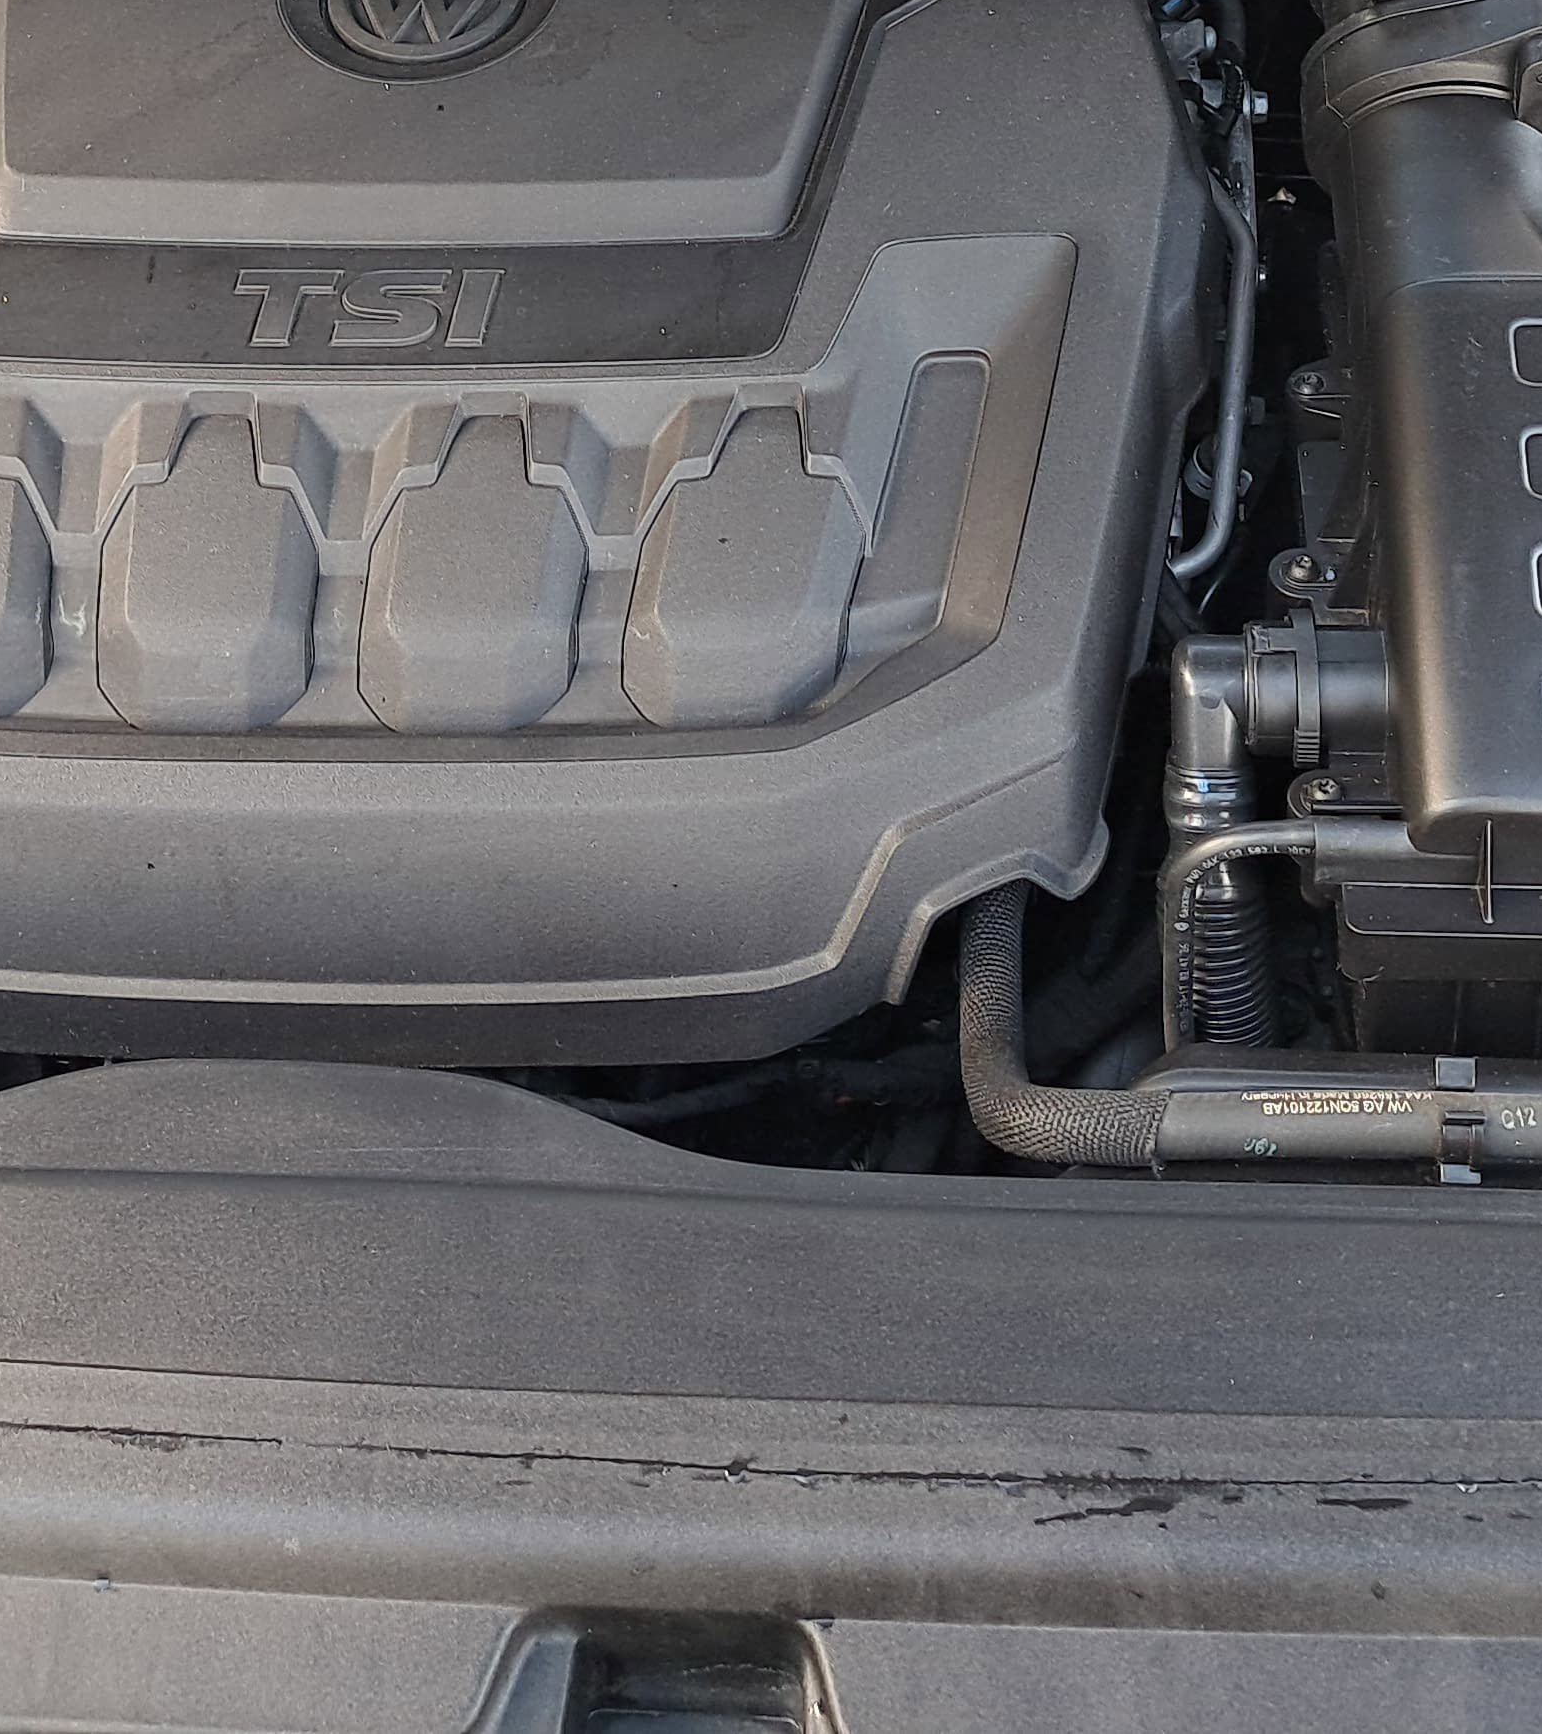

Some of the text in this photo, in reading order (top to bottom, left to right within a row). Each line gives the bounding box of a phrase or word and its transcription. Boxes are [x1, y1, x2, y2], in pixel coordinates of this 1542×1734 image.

[233, 267, 505, 347] TSI
[1263, 1101, 1412, 1115] VW AG 5QN122101AB
